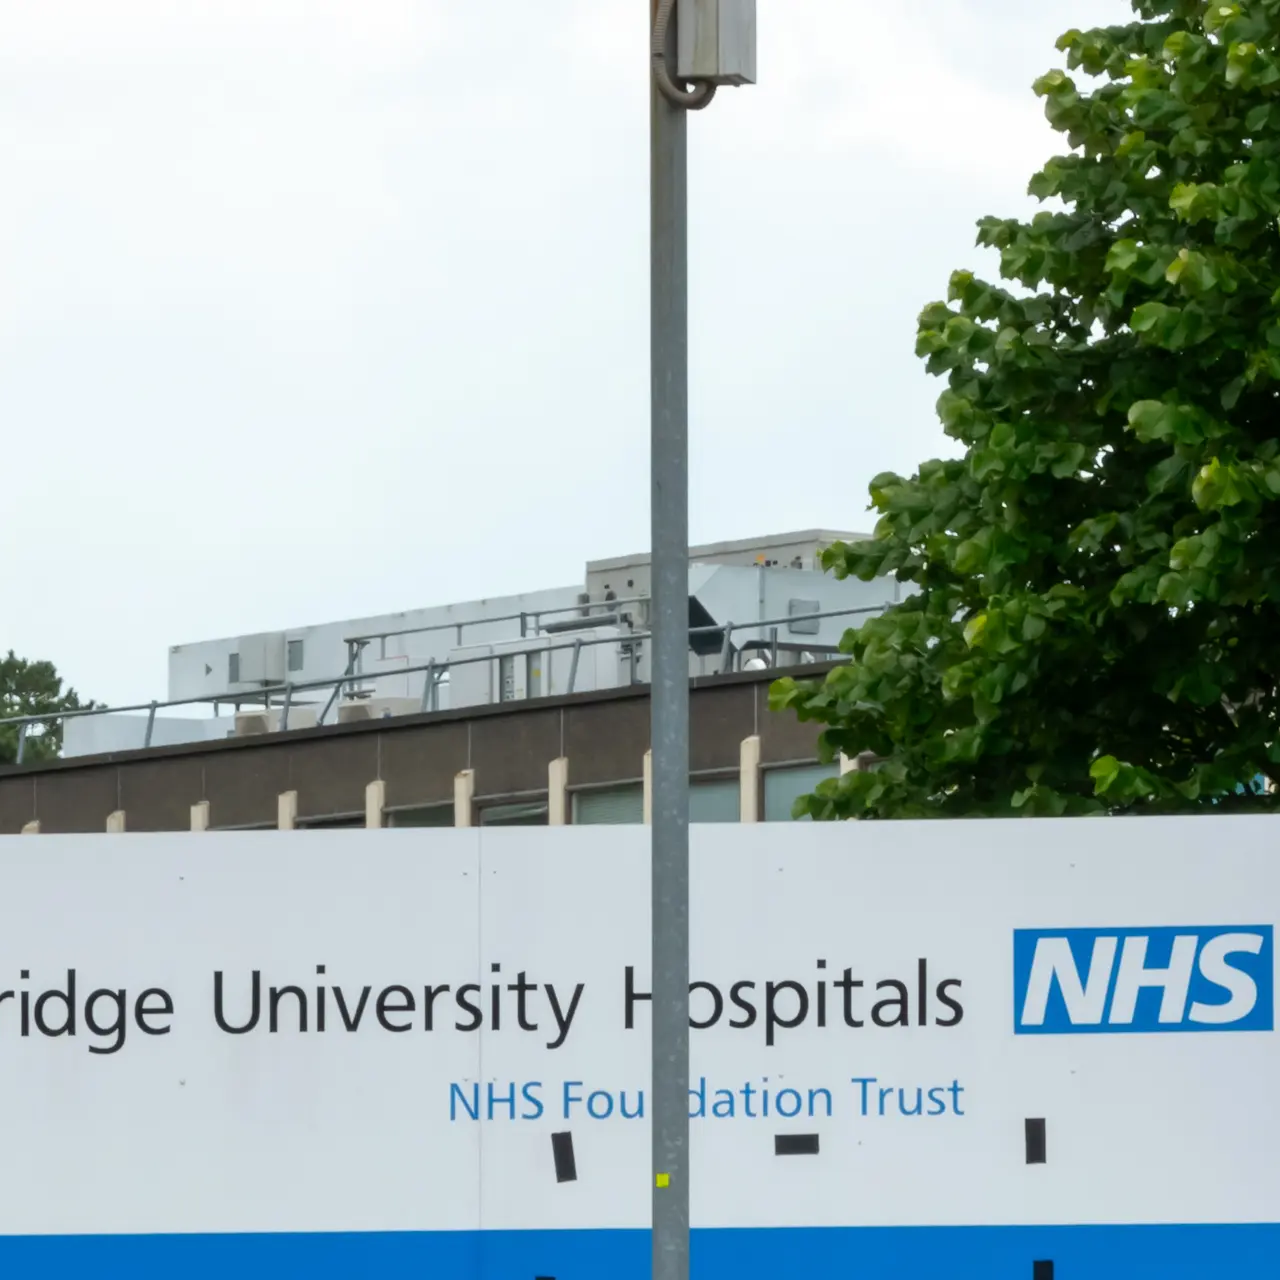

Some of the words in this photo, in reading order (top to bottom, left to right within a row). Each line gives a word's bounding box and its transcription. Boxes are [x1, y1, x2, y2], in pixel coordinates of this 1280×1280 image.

[213, 962, 585, 1050] University
[624, 957, 964, 1047] Hospitals
[1020, 933, 1264, 1026] NHS
[449, 1081, 545, 1121] NHS
[563, 1076, 833, 1120] Foudation
[851, 1077, 965, 1117] Trust
